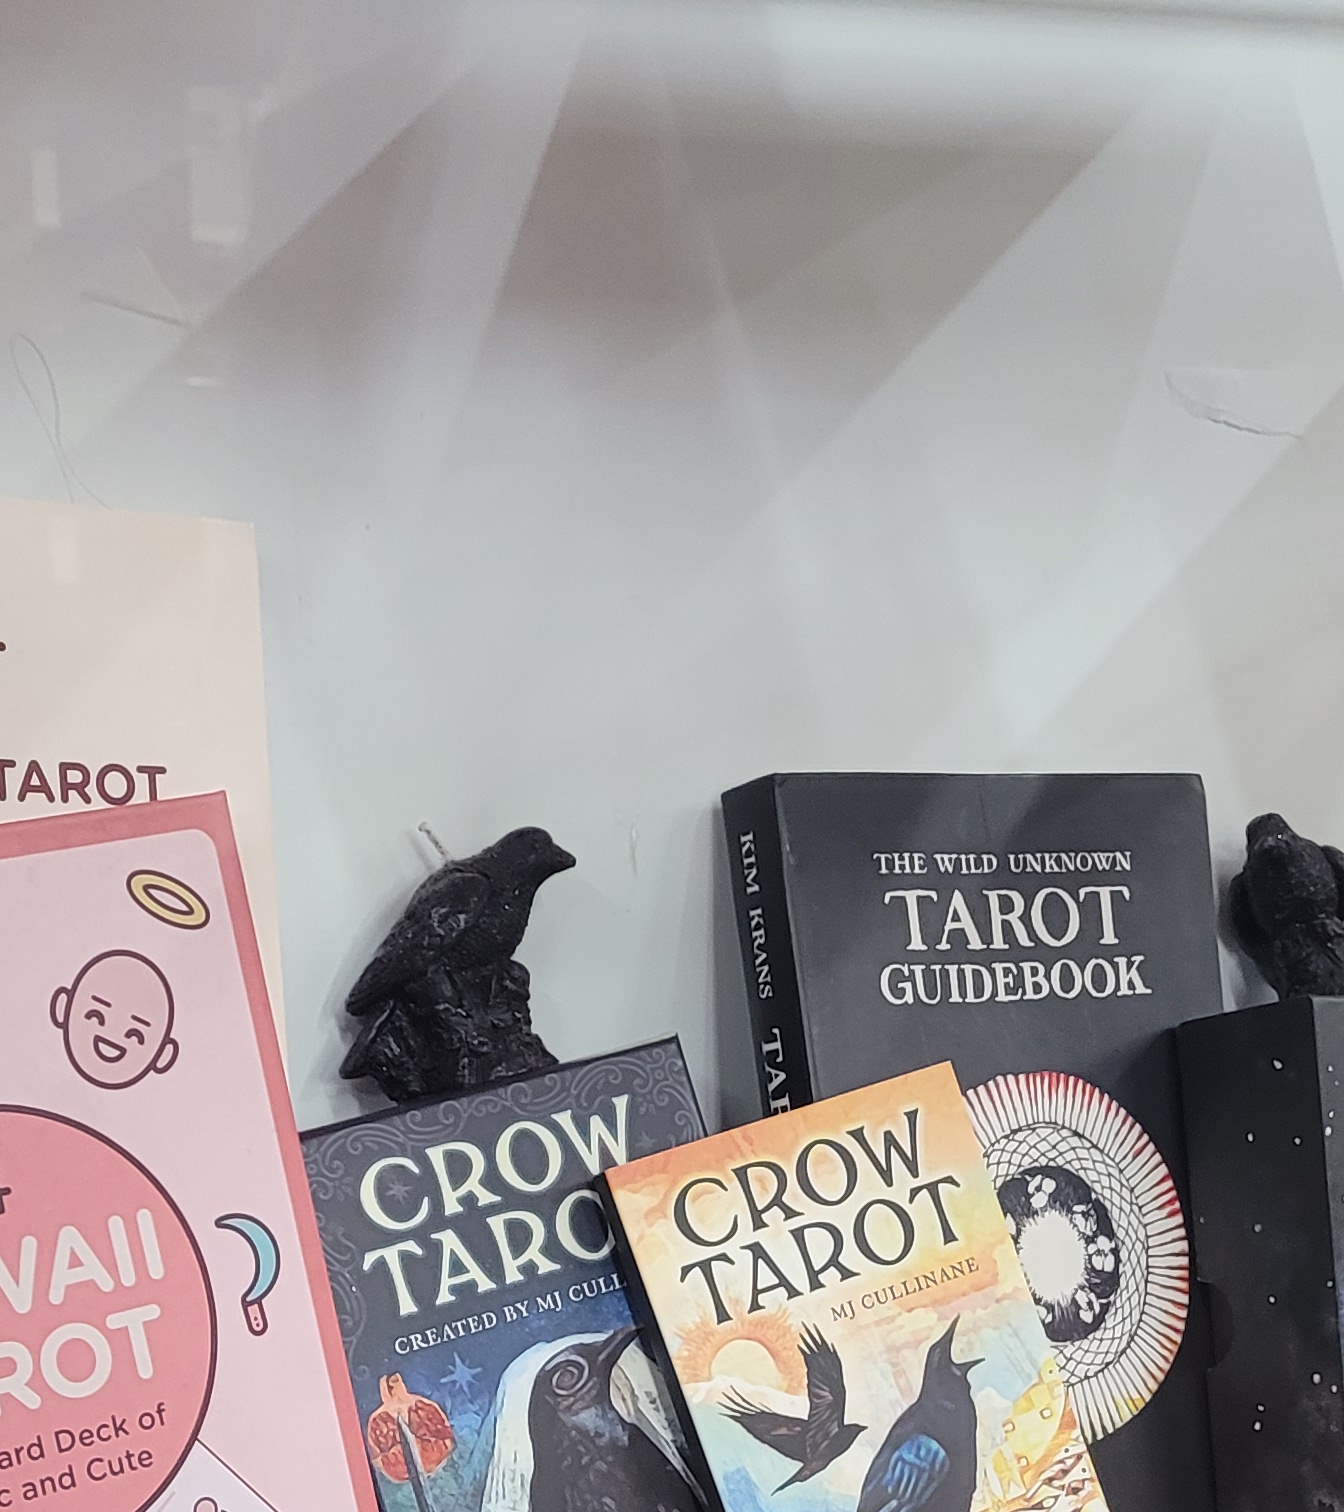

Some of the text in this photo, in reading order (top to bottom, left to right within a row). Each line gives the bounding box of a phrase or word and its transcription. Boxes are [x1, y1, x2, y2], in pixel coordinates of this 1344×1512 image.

[739, 830, 760, 896] KIM
[873, 850, 1132, 876] THE WILD UNKNOWN
[884, 885, 1131, 951] TAROT
[748, 907, 774, 1000] KRANS
[879, 955, 1152, 1005] GUIDEBOOK
[360, 1094, 629, 1231] CROW
[674, 1108, 923, 1248] CROW
[363, 1189, 616, 1317] TARO
[679, 1174, 961, 1328] TAROT
[829, 1255, 980, 1323] MJ CULLINANE
[394, 1311, 498, 1355] CREATED
[503, 1299, 530, 1323] BY
[536, 1290, 563, 1312] MJ
[56, 1415, 130, 1456] Deck
[138, 1402, 167, 1432] of
[22, 1468, 77, 1502] and
[86, 1446, 154, 1484] Cute
